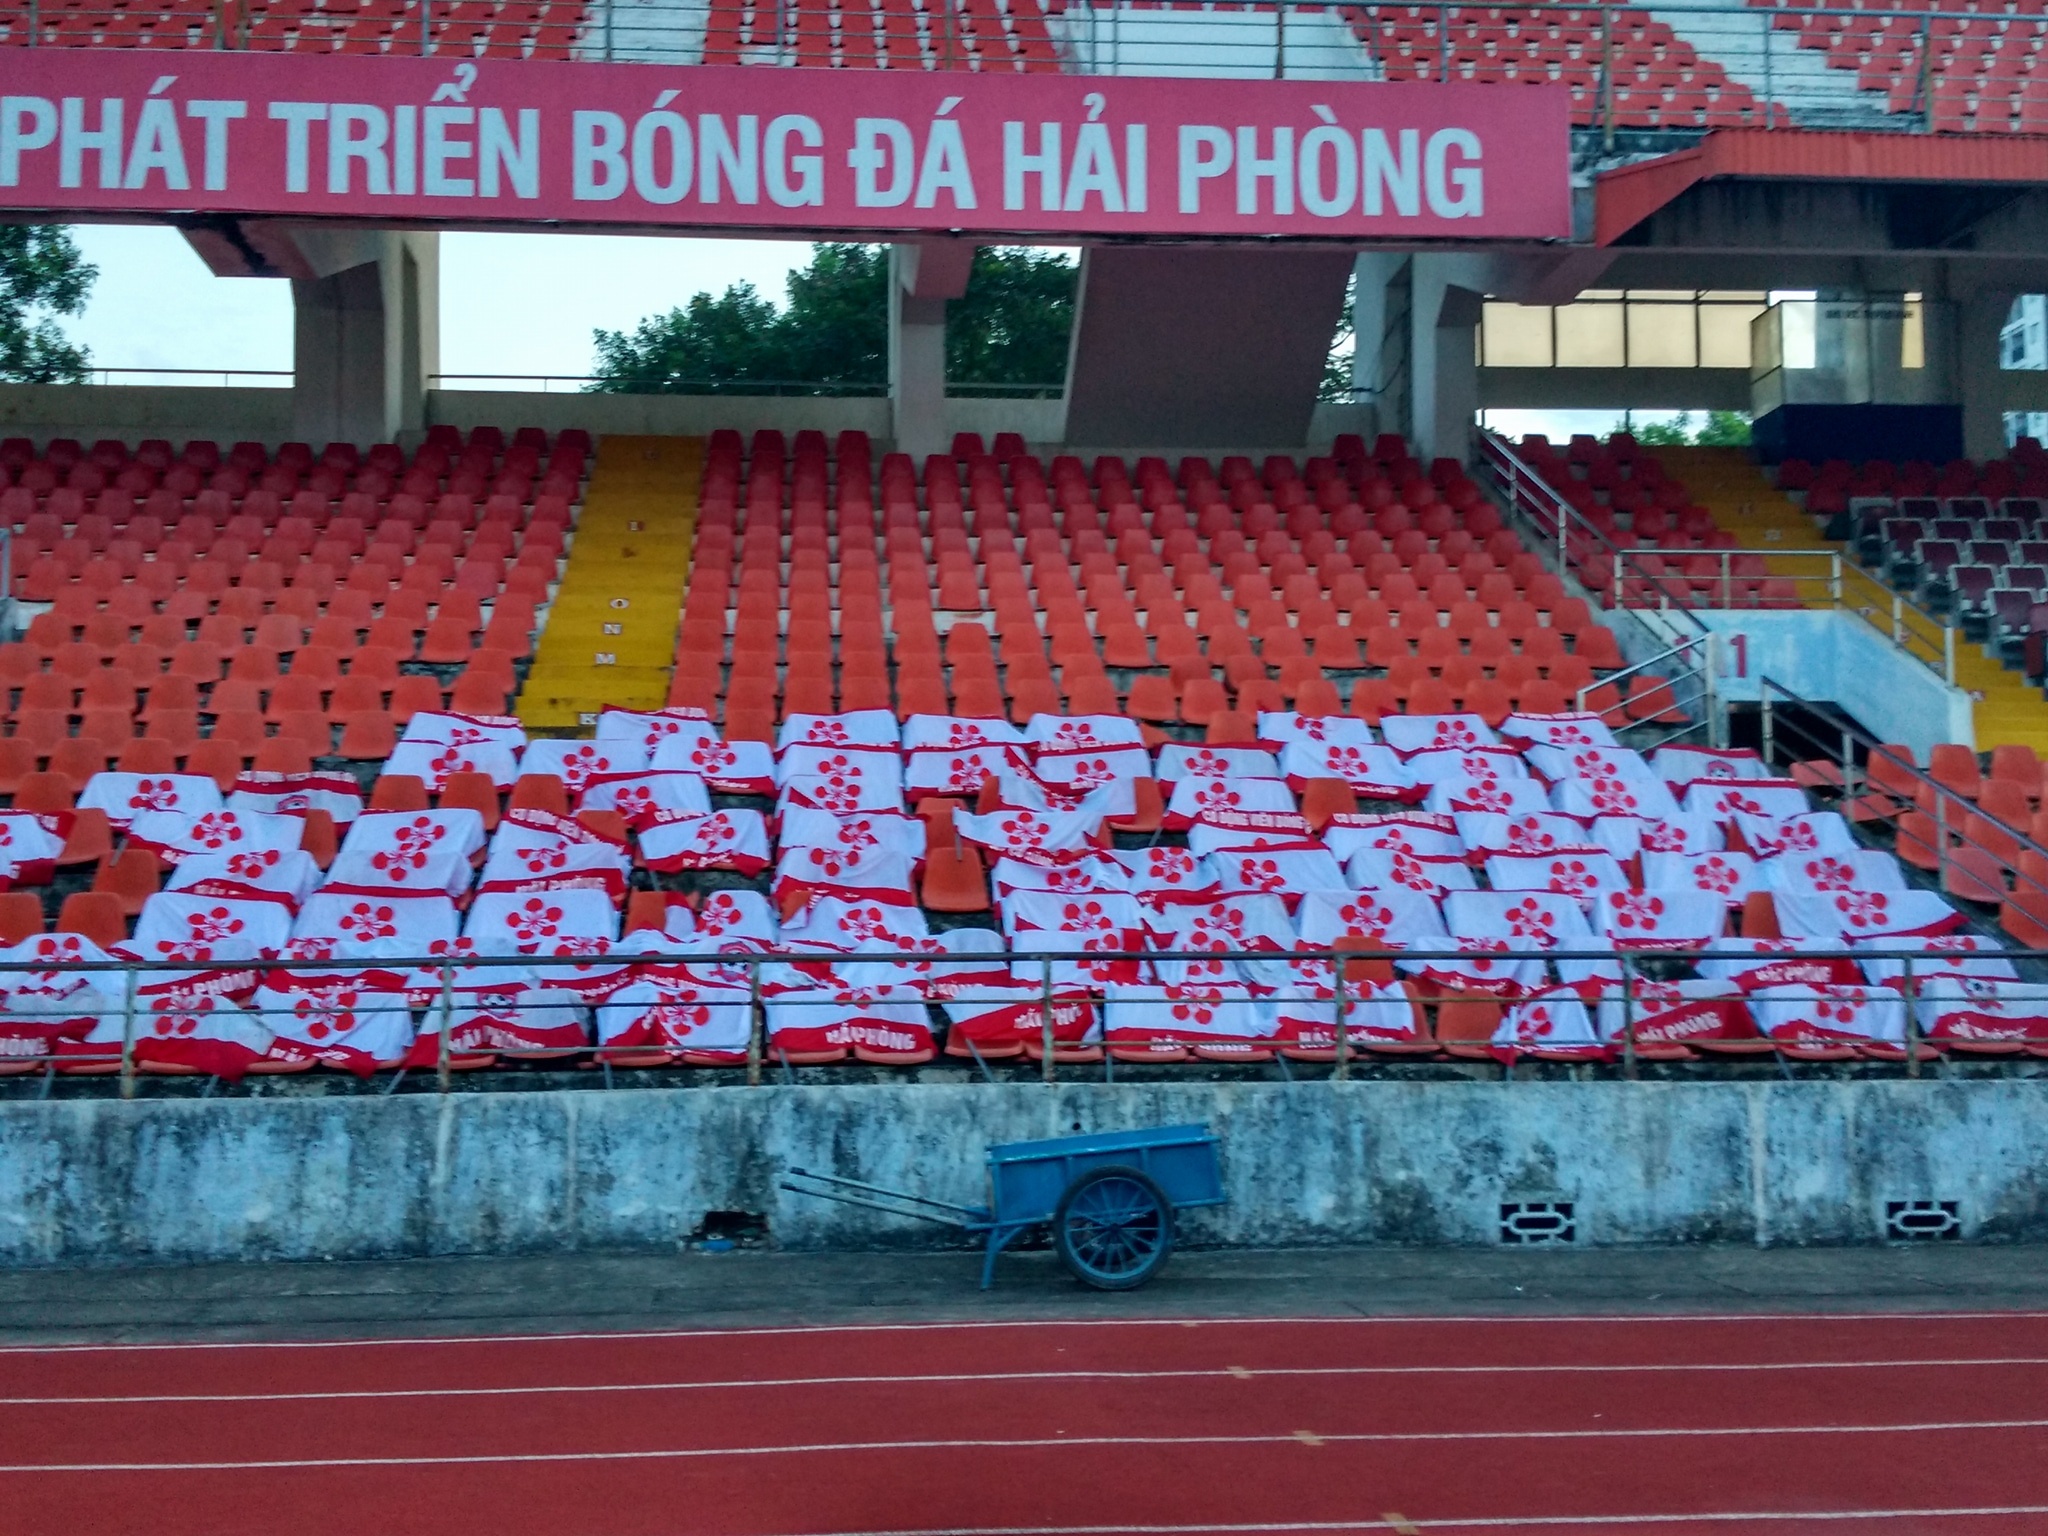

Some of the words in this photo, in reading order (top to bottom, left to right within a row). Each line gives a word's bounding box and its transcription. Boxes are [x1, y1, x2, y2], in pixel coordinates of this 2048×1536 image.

[0, 76, 246, 191] PHÁT
[269, 63, 539, 198] TRIỂN
[572, 90, 824, 207] BÓNG
[848, 96, 977, 209] ĐÁ
[1003, 92, 1147, 212] HẢI
[1178, 104, 1483, 218] PHÒNG
[1730, 634, 1746, 678] 1
